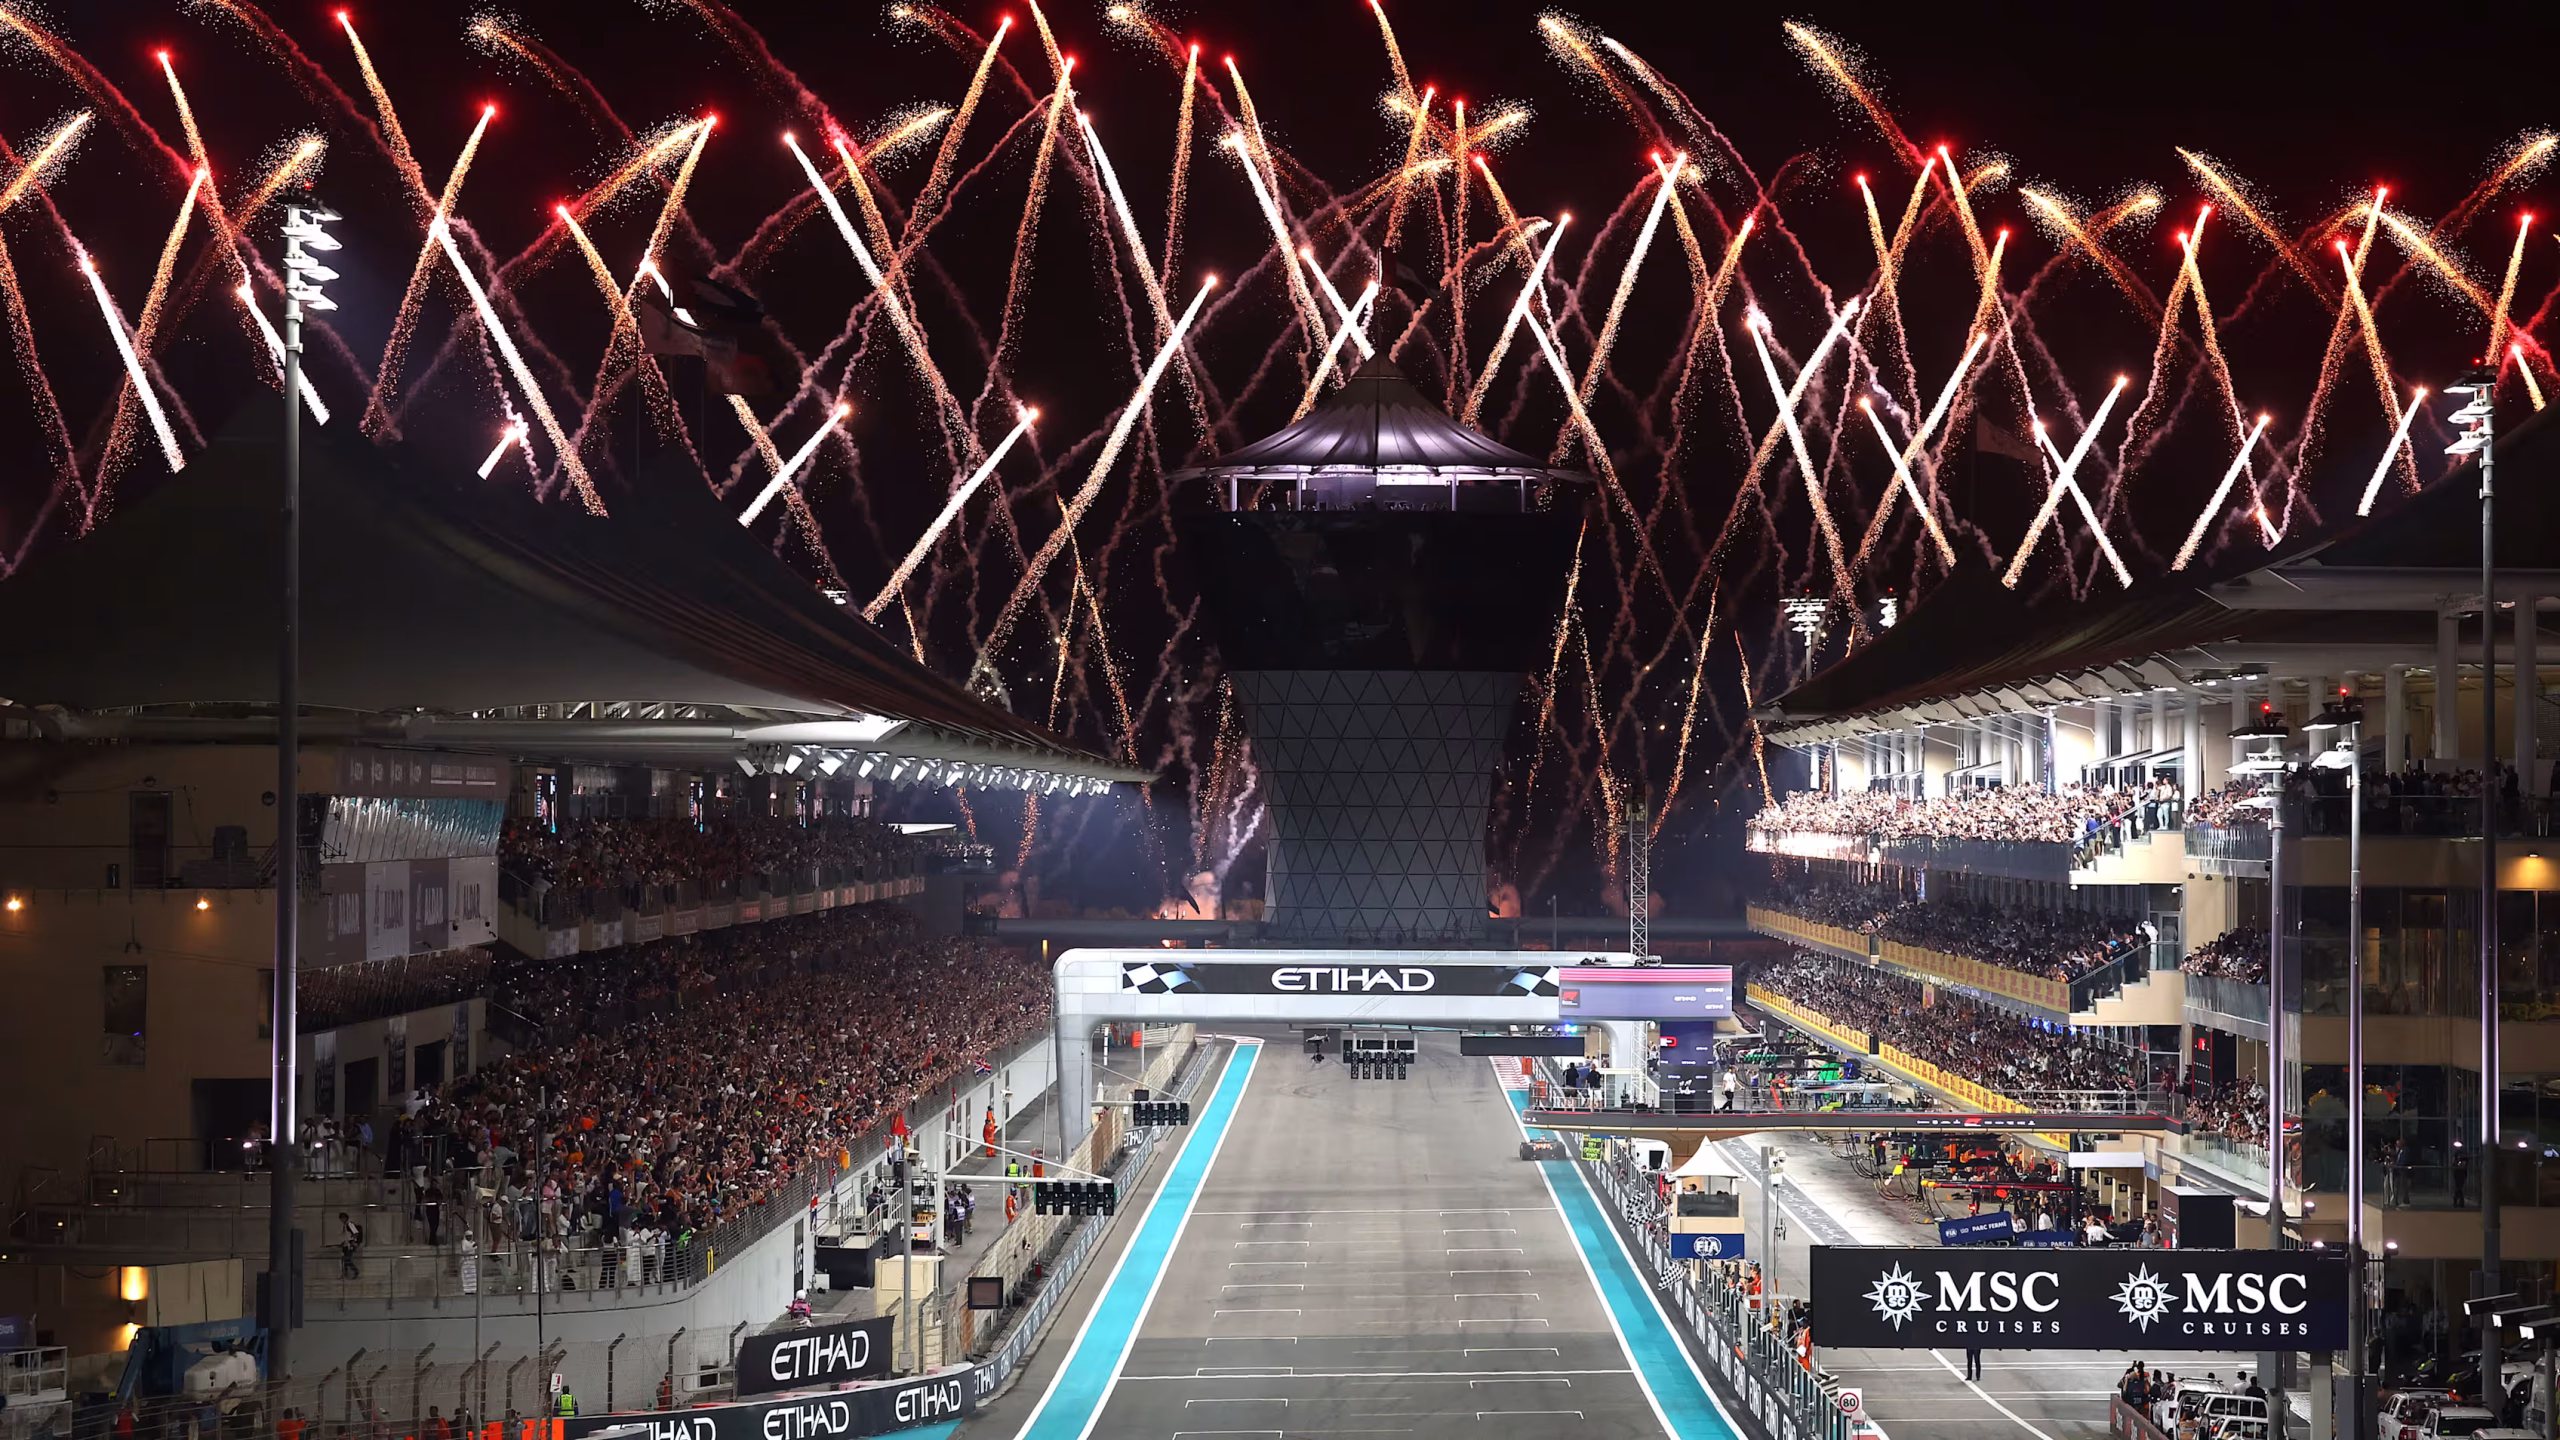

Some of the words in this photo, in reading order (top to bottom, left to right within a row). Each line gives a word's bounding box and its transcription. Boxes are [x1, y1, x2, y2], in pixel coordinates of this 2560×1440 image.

[1271, 967, 1436, 991] ETIHAD
[1972, 1224, 1987, 1232] PARC
[1695, 1240, 1720, 1253] FIA
[1934, 1271, 2060, 1312] MSC
[2182, 1273, 2307, 1314] MSC
[1935, 1320, 2060, 1333] CRUISES
[2182, 1322, 2308, 1335] CRUISES
[771, 1330, 870, 1381] ETIHAD
[895, 1380, 961, 1422] ETIHAD
[1843, 1398, 1856, 1408] 80
[606, 1417, 716, 1440] IHAD
[763, 1401, 850, 1440] ETIHAD
